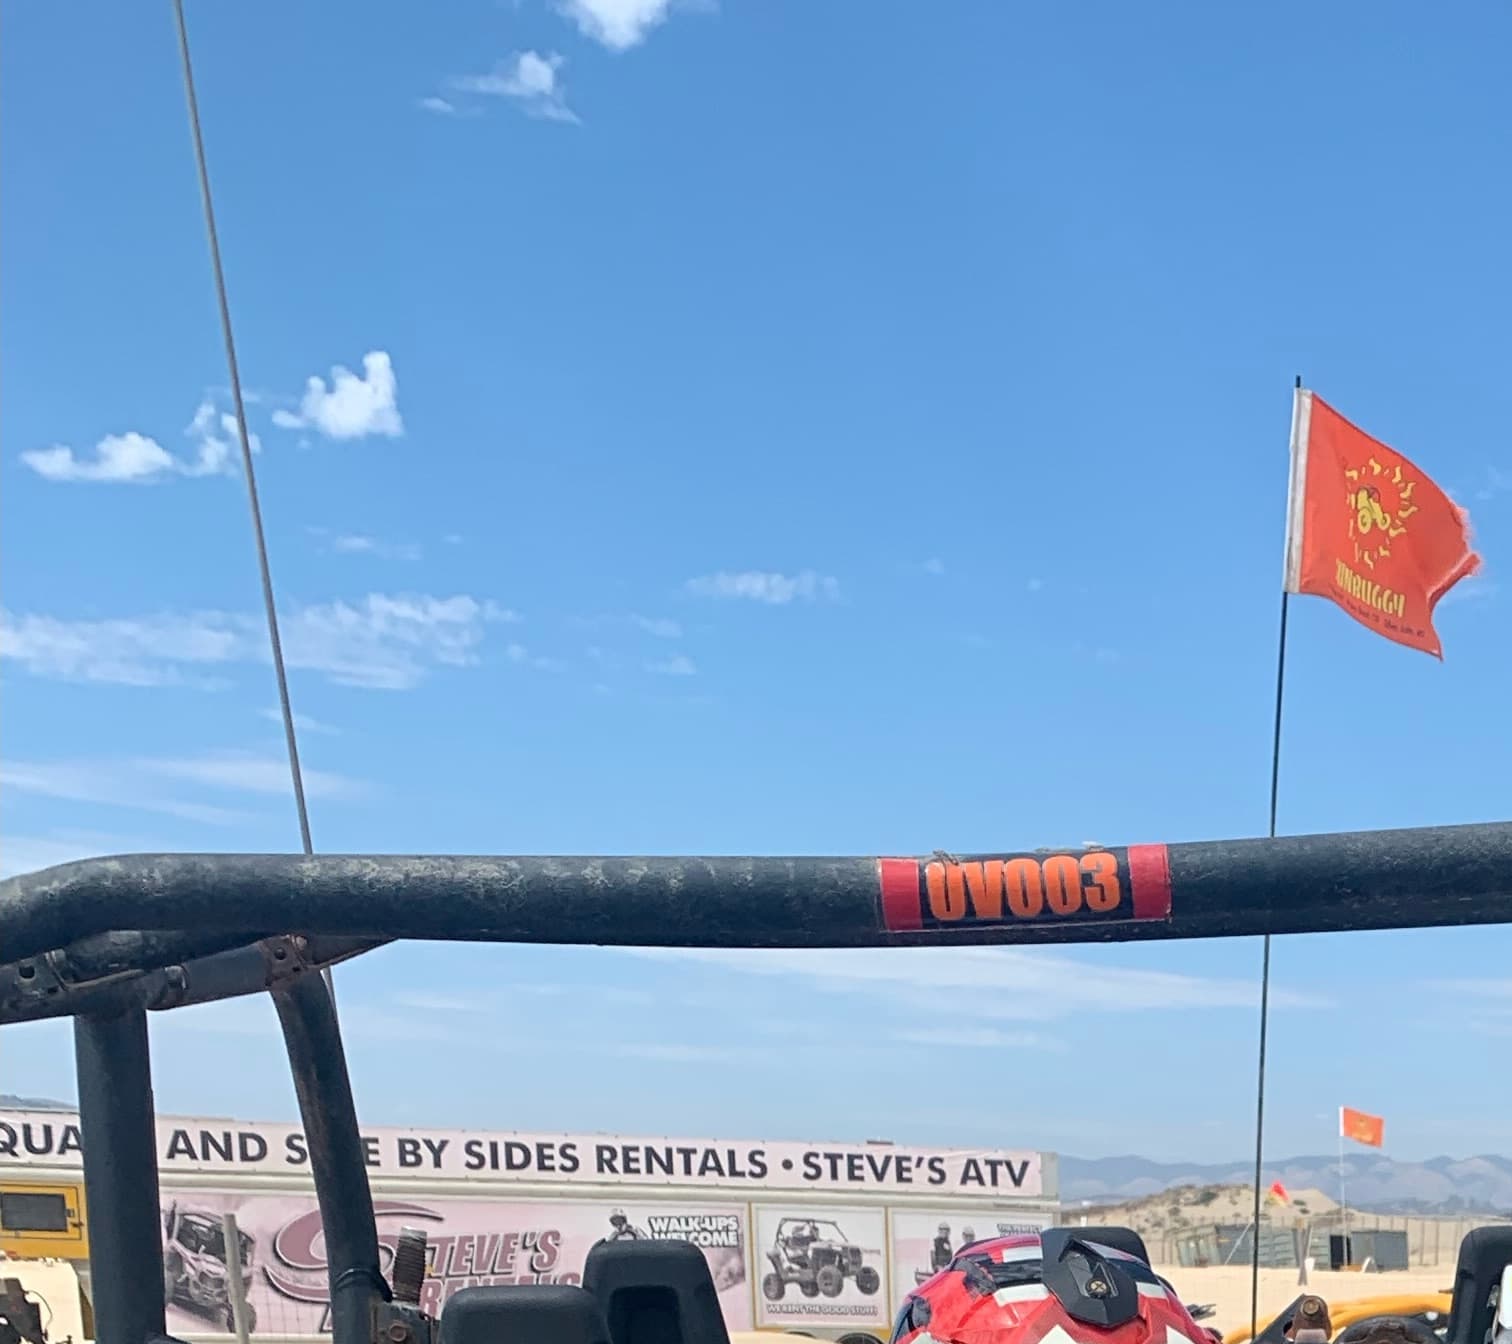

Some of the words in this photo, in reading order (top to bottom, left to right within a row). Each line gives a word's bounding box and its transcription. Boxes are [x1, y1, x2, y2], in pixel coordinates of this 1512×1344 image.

[1335, 558, 1406, 618] UNBUGGY
[0, 1122, 82, 1157] QUA
[166, 1129, 268, 1162] AND
[285, 1133, 381, 1167] SE
[397, 1137, 450, 1169] BY
[464, 1140, 579, 1173] SIDES
[596, 1144, 768, 1179] RENTALS
[802, 1151, 946, 1187] STEVE'S
[960, 1157, 1030, 1188] ATV
